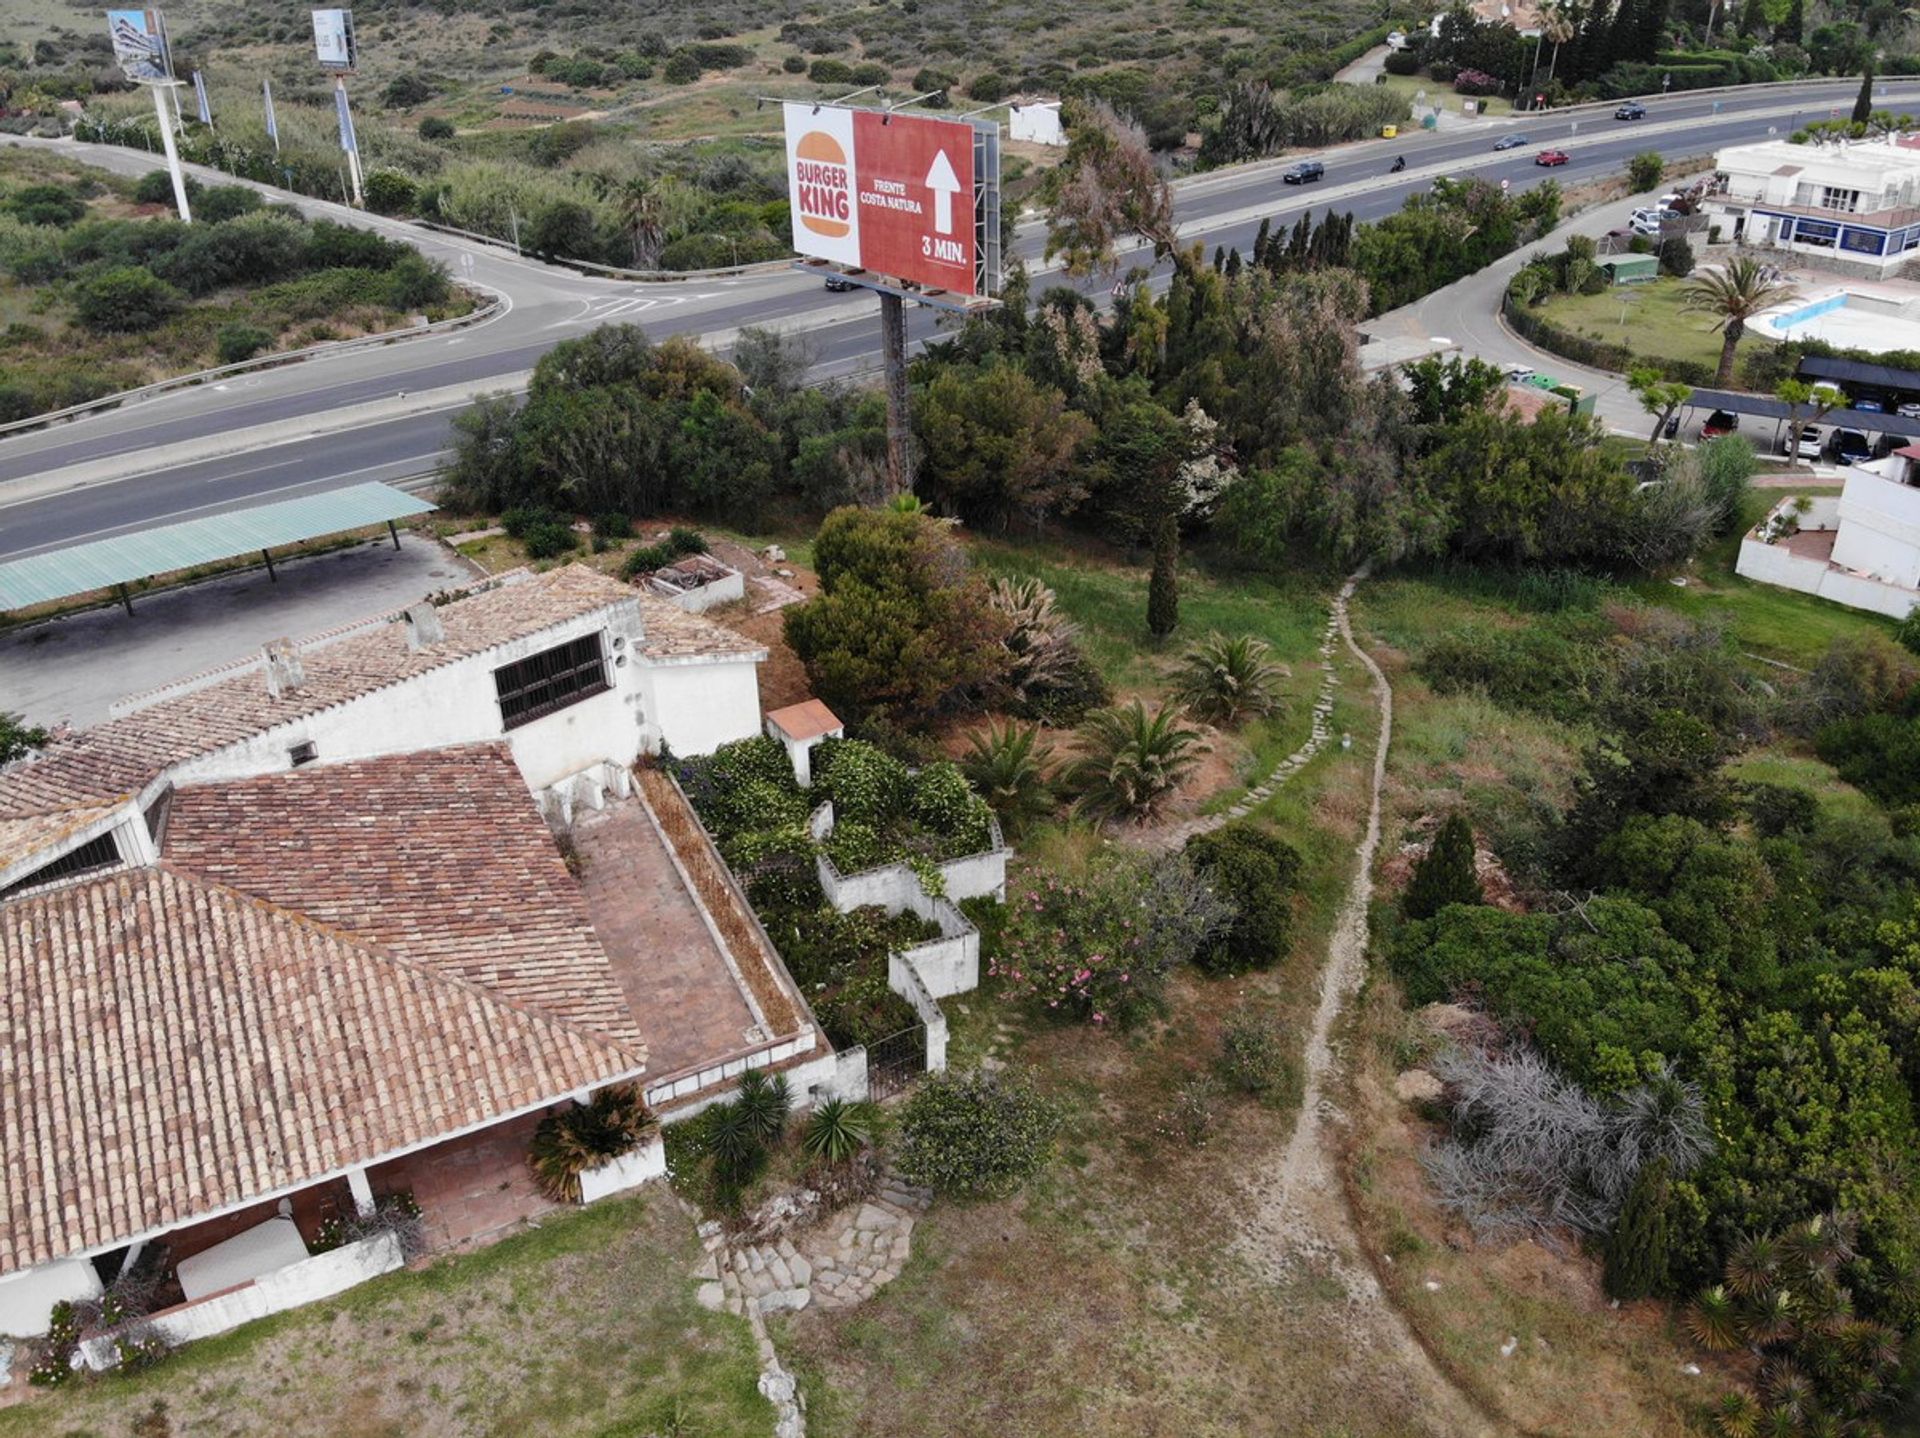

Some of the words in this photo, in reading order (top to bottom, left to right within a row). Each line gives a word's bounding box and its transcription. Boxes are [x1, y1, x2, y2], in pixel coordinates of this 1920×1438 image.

[797, 161, 848, 190] BURGER
[873, 179, 906, 196] FRENTE
[799, 184, 849, 220] KING
[860, 191, 887, 208] COSTA
[887, 196, 922, 214] NATURA
[922, 235, 931, 256] 3
[934, 238, 967, 265] MIN.
